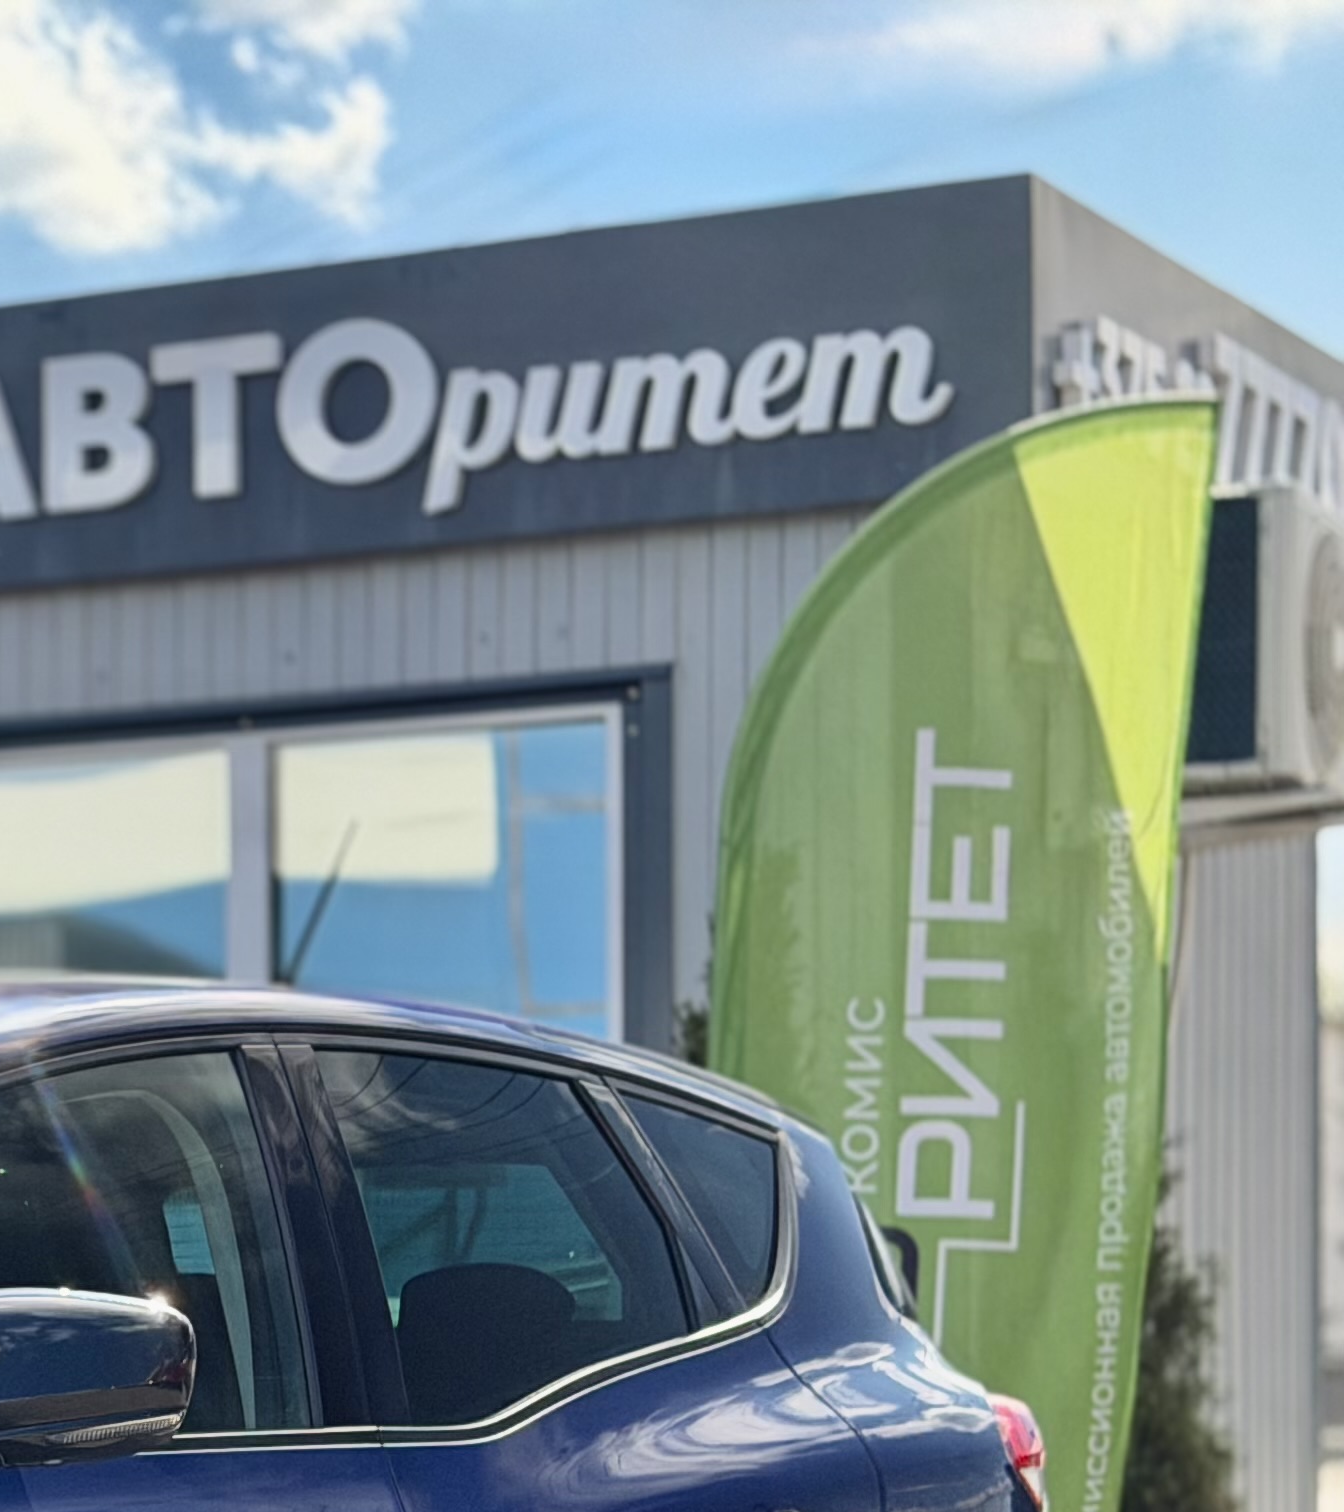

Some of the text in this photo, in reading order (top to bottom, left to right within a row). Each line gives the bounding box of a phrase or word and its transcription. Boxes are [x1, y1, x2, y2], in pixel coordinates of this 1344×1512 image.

[896, 727, 1012, 1220] РИТЕТ
[1092, 806, 1134, 1082] автомобилей
[1096, 1091, 1131, 1271] продажа
